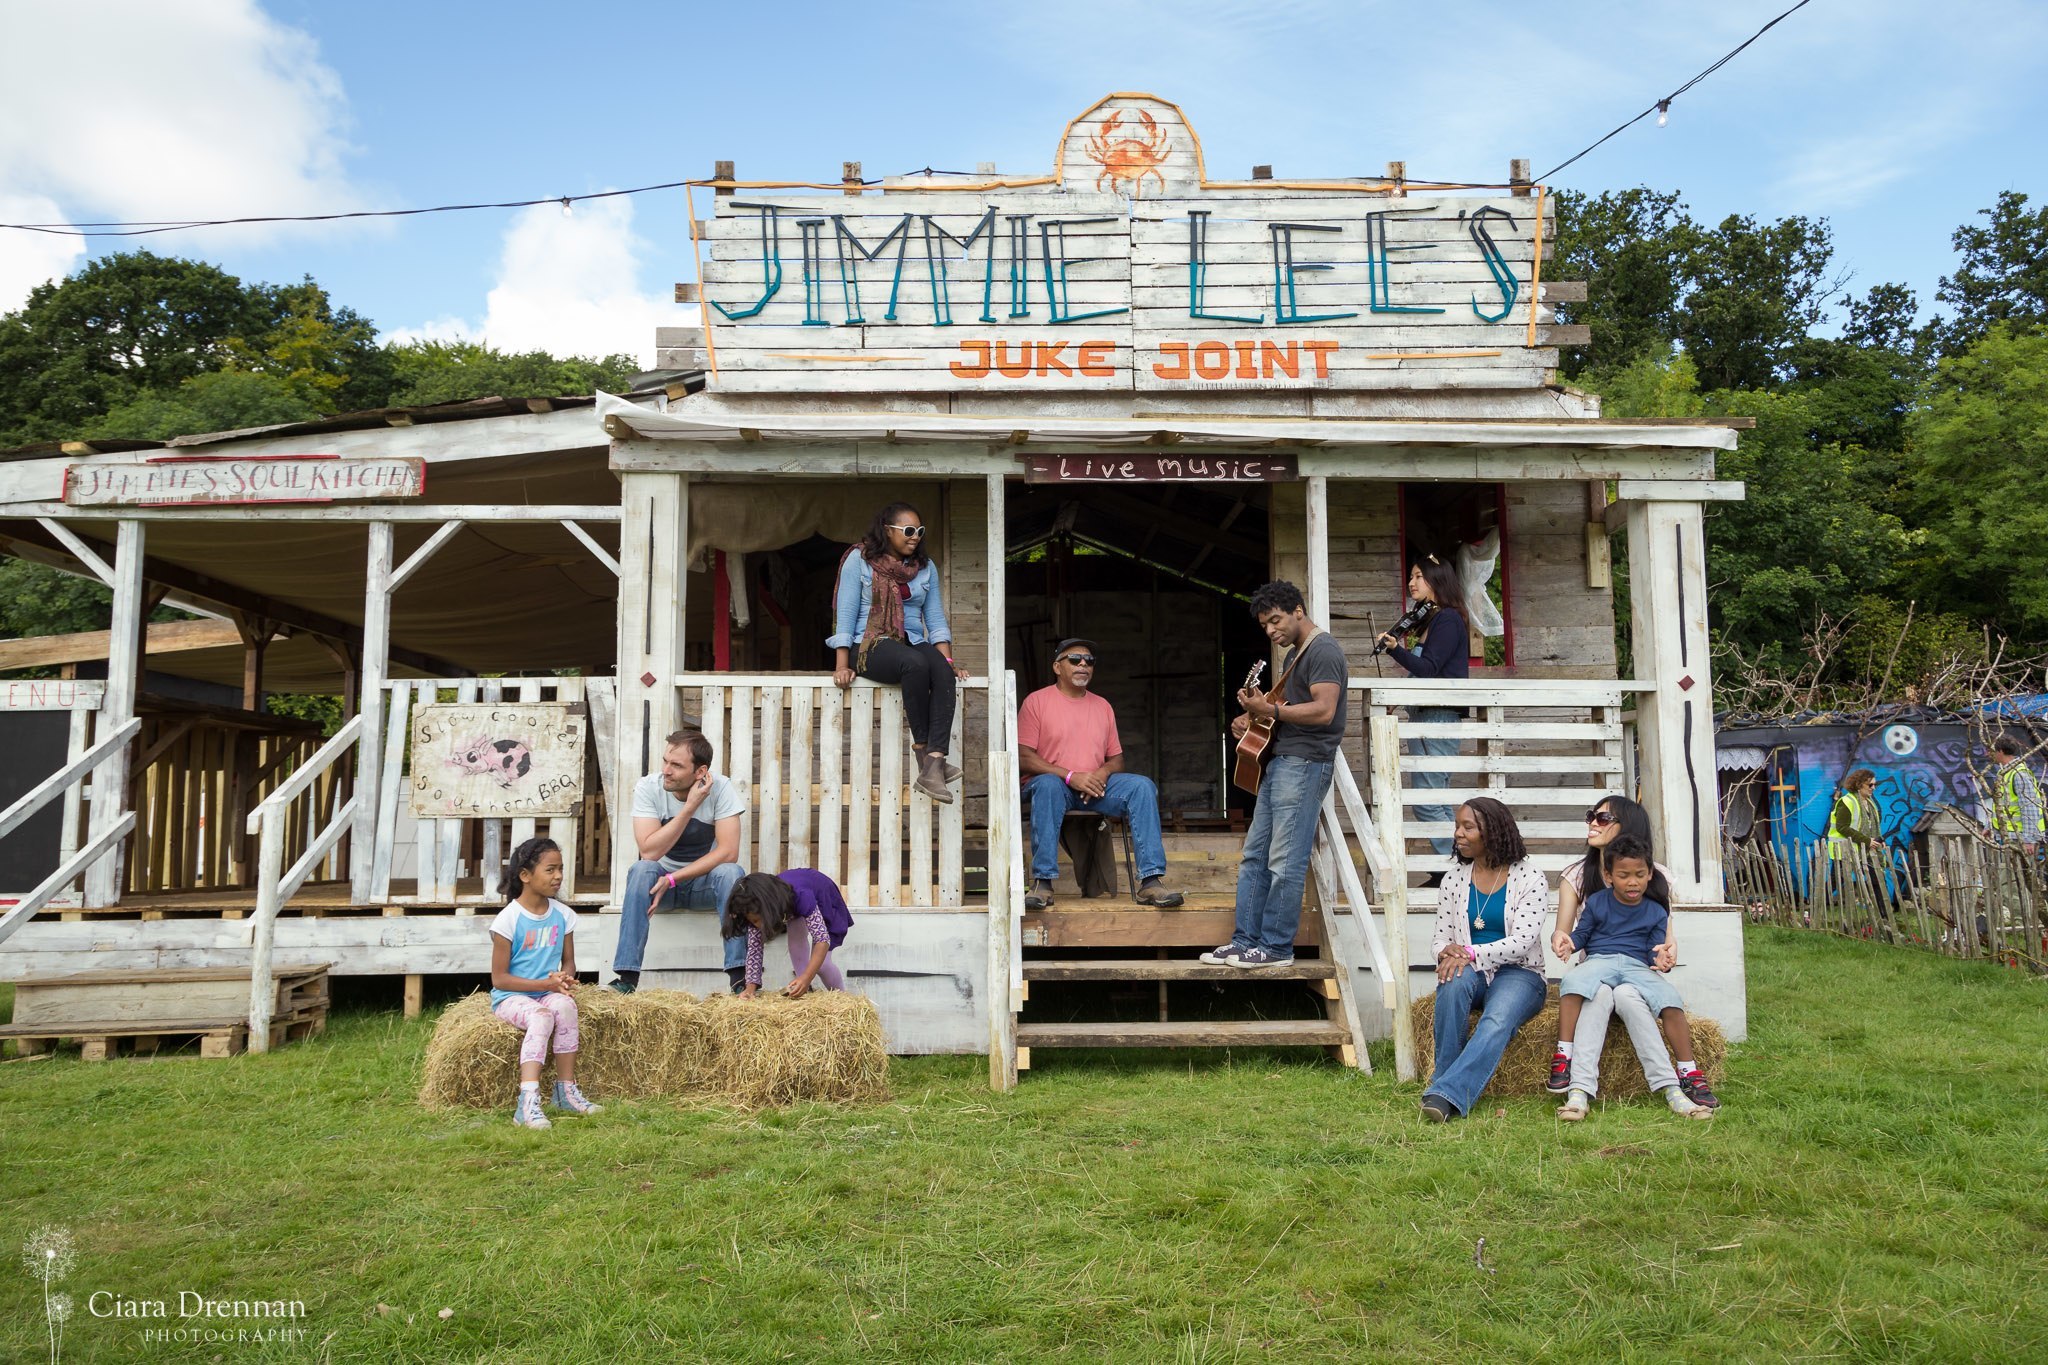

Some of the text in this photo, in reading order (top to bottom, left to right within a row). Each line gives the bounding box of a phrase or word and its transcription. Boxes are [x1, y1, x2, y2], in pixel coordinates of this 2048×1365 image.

[711, 202, 1519, 327] JIMMIE LEE'S
[949, 340, 1340, 380] JUKE JOINT
[225, 463, 305, 493] SOUL
[417, 774, 577, 813] Southern BBQ
[522, 925, 558, 950] NIKE
